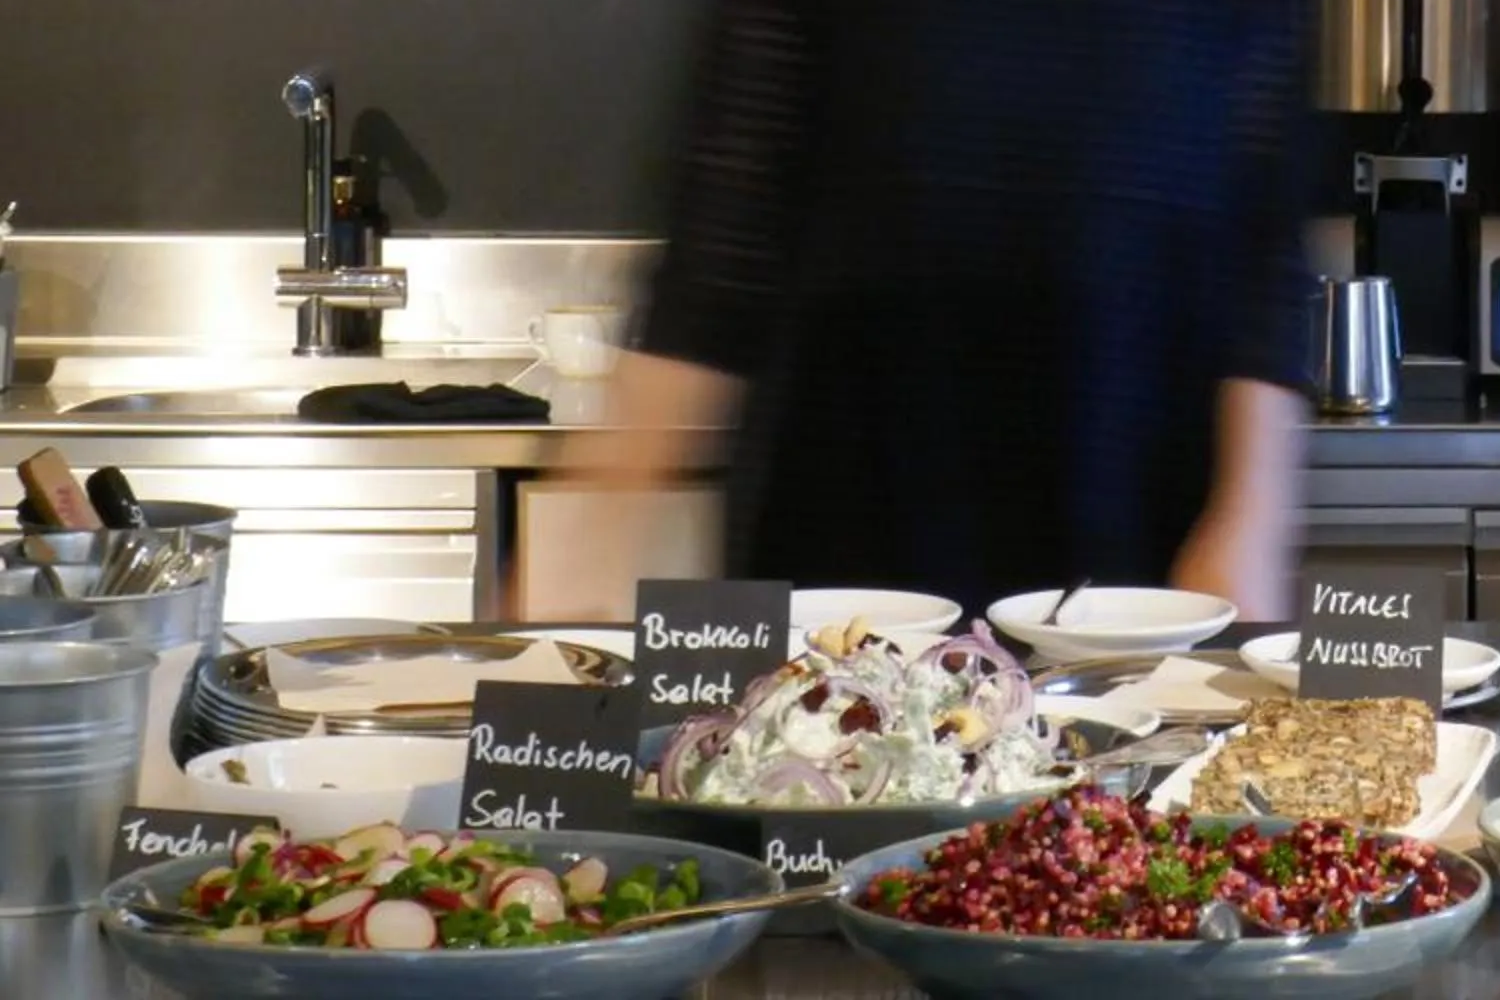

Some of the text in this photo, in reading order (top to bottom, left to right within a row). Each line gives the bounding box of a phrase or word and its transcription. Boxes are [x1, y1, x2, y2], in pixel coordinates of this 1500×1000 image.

[1312, 583, 1412, 618] VITALES
[642, 612, 770, 650] Brokkoli
[650, 671, 734, 705] Salat
[471, 723, 633, 779] Radischen
[465, 789, 565, 830] Salat
[766, 838, 844, 875] Buch
